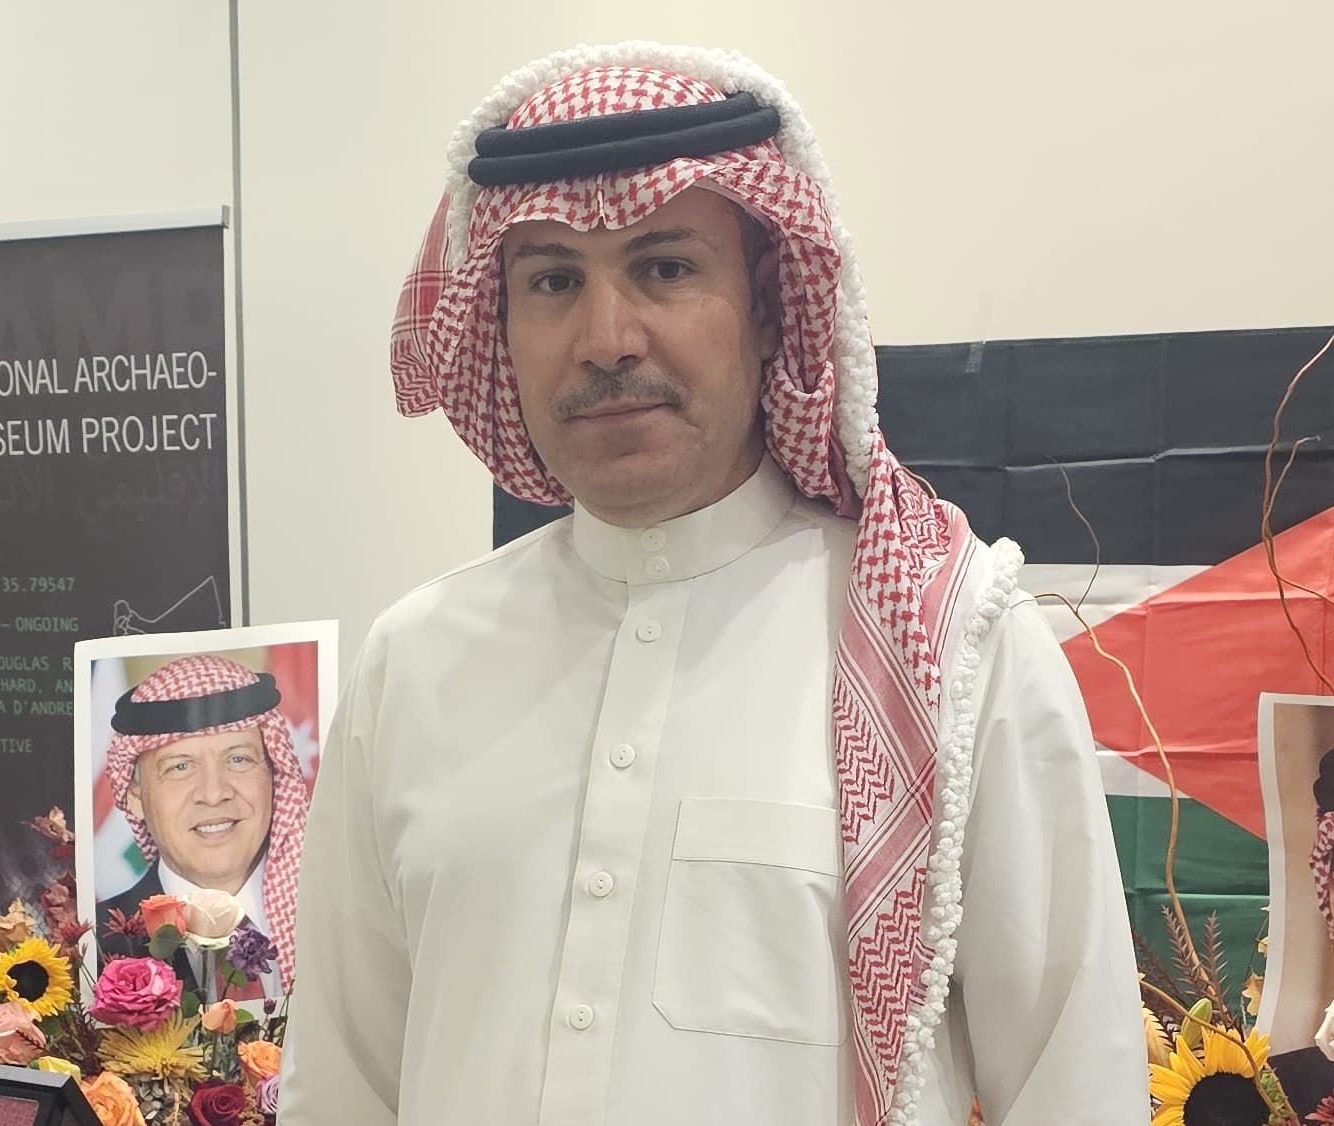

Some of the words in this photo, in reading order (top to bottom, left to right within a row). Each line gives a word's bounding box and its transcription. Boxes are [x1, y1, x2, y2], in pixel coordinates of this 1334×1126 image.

[73, 350, 218, 393] ARCHAEO-
[82, 413, 218, 453] PROJECT
[1, 576, 76, 593] 35.79547
[14, 616, 80, 633] ONGOING
